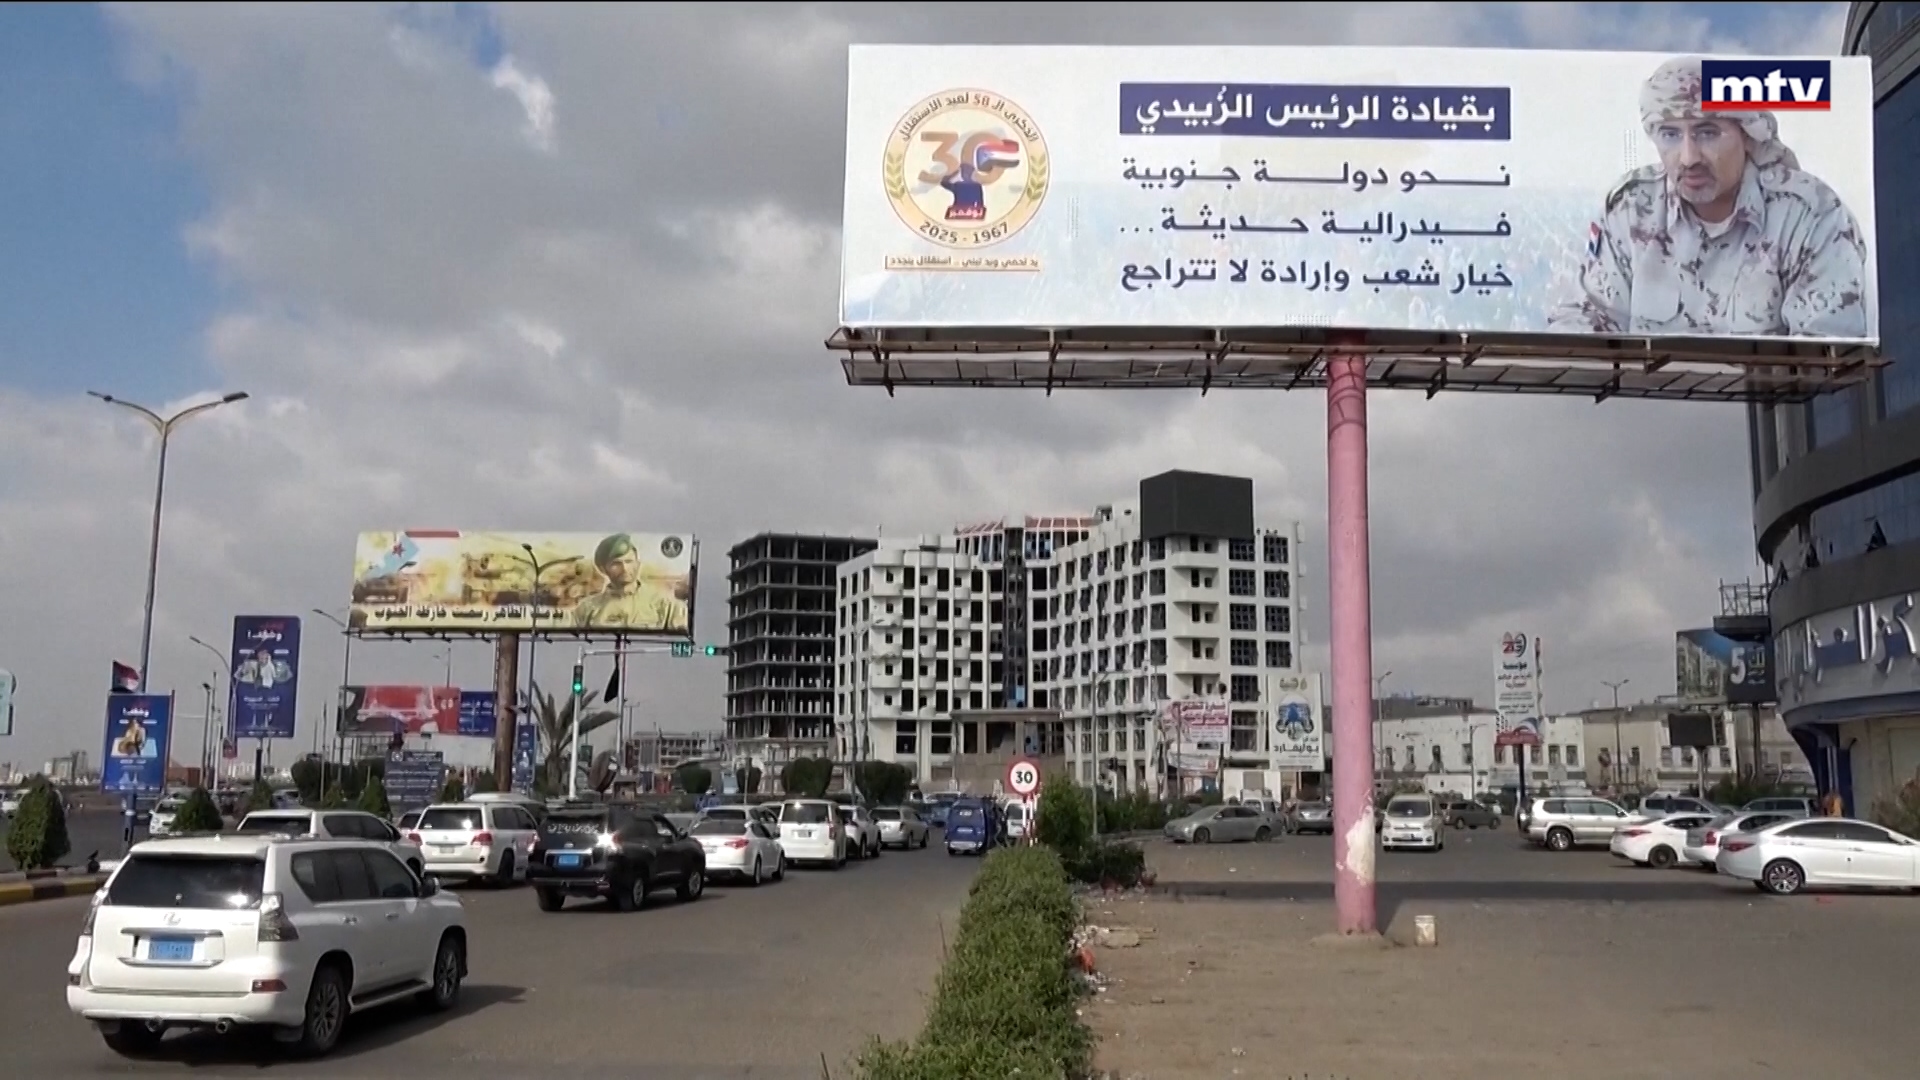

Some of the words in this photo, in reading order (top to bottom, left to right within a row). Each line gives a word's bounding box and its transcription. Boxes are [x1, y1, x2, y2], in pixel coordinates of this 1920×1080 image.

[1265, 93, 1379, 130] الرئيس
[1391, 95, 1495, 132] بقيادة
[1122, 157, 1242, 191] جنوبية
[1253, 159, 1389, 193] دولة
[1399, 165, 1511, 194] نحو
[919, 221, 958, 244] 2025
[973, 221, 1008, 244] 1967
[1321, 209, 1512, 245] فيدرالية
[1121, 257, 1217, 292] تتراجع
[1228, 258, 1249, 284] لا
[1260, 259, 1350, 292] وإرادة
[1362, 258, 1441, 294] شعب
[1450, 263, 1513, 296] خيار
[1015, 770, 1033, 784] 30
